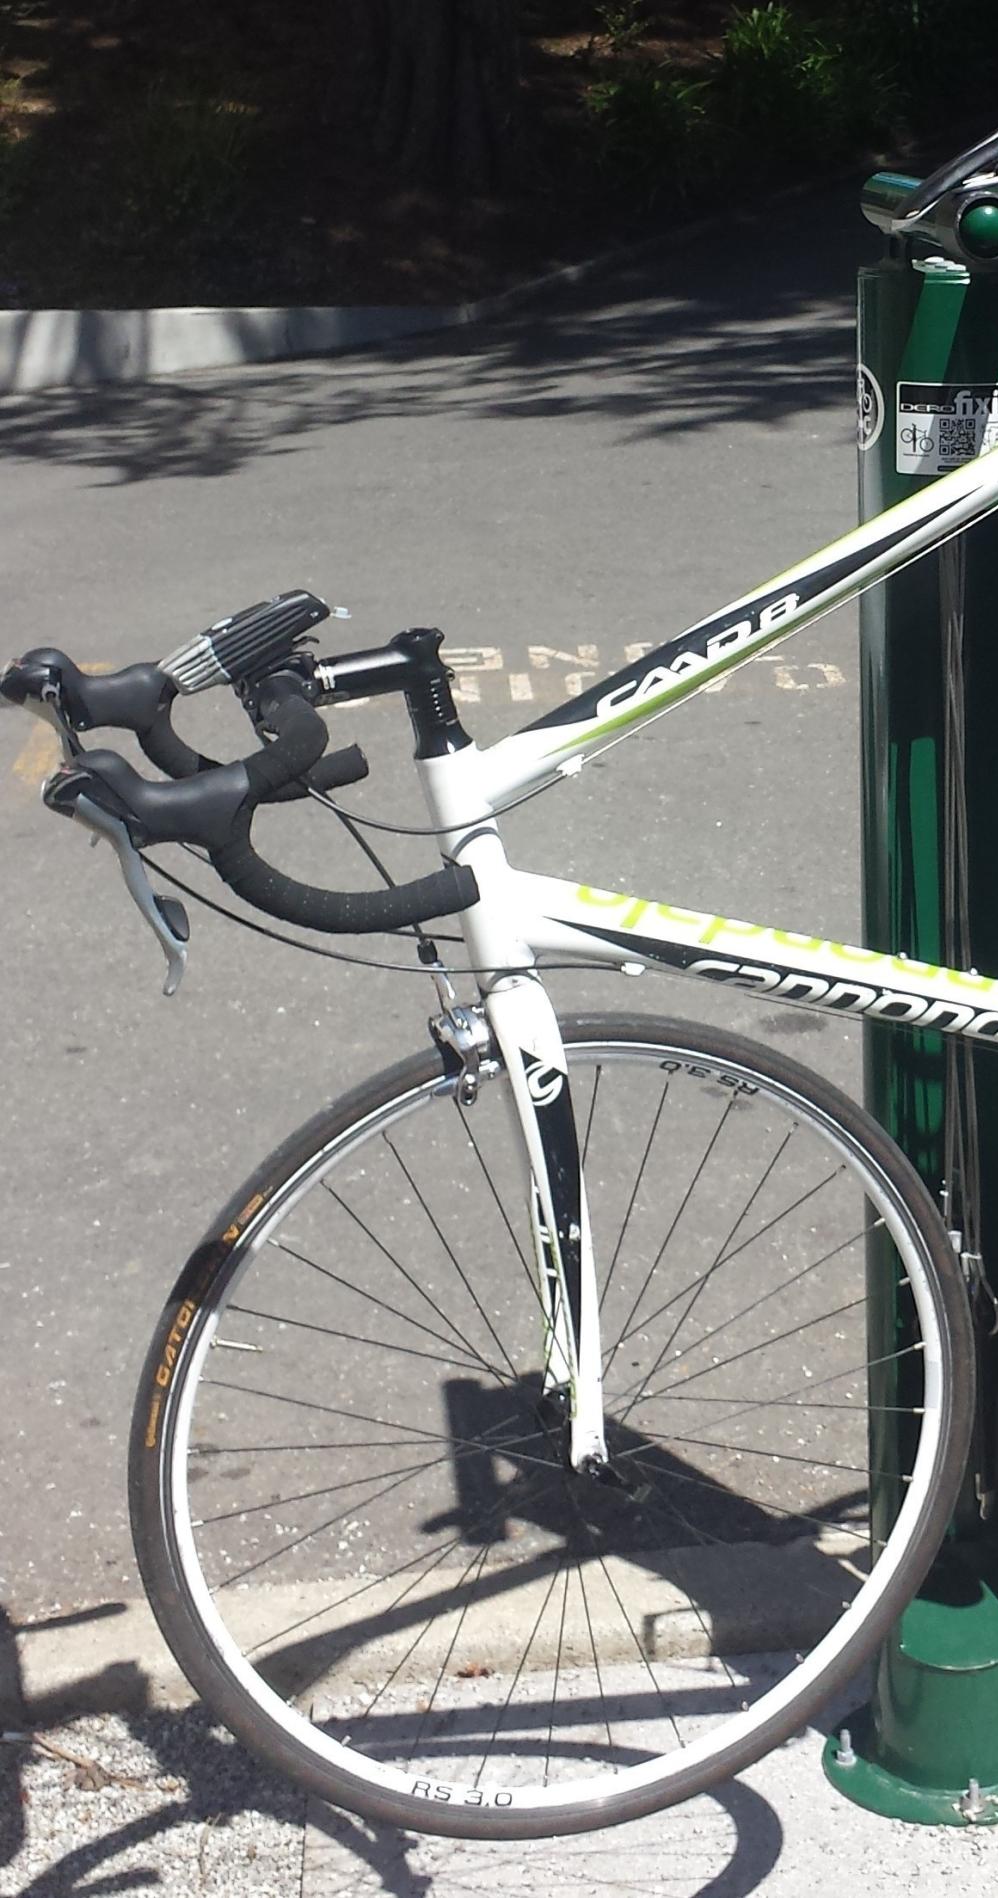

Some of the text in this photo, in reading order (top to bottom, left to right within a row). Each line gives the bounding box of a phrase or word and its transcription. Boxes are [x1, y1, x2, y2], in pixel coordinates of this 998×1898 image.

[900, 402, 955, 413] DERO
[411, 1780, 513, 1807] RS 3.0
